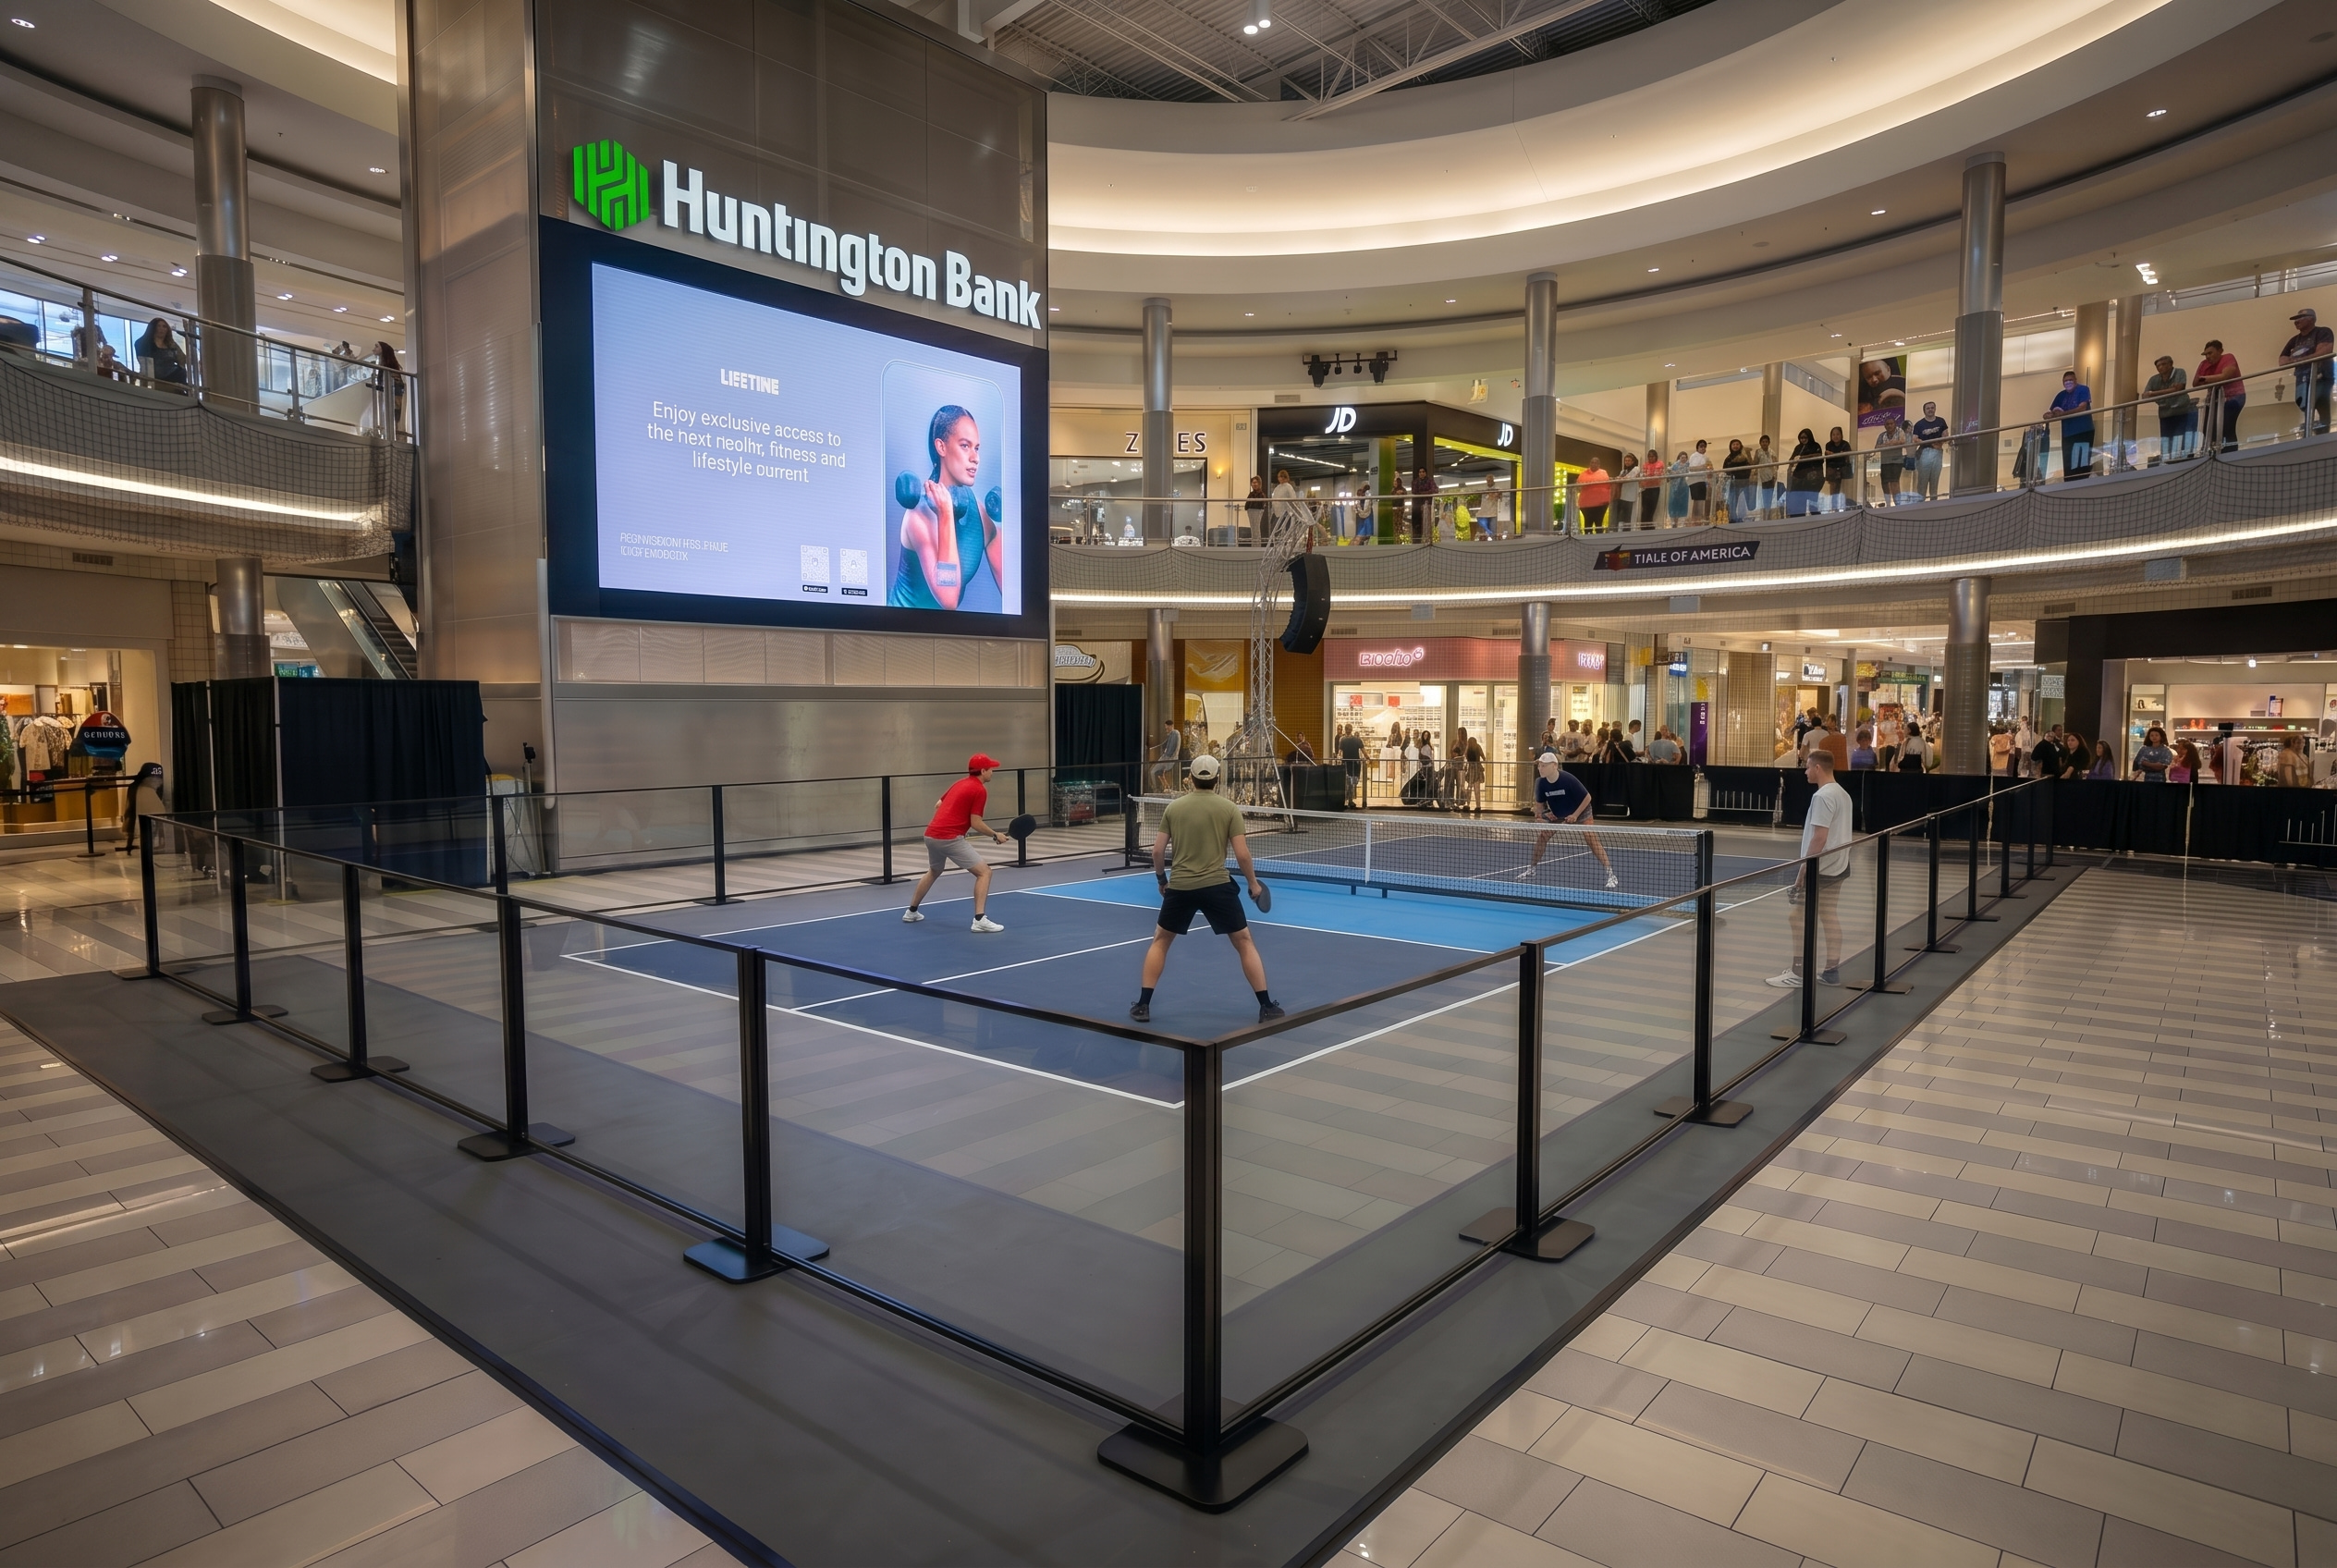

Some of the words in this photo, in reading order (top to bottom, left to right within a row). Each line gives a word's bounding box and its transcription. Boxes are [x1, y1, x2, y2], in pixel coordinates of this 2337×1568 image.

[662, 158, 937, 300] Huntington
[946, 250, 1043, 330] Bank
[653, 400, 696, 427] Enjoy
[701, 412, 771, 435] exclusive
[775, 423, 824, 445] access
[827, 431, 841, 447] to
[1325, 407, 1357, 435] JD
[1497, 422, 1514, 447] JD
[647, 423, 674, 442] the
[678, 428, 712, 447] next
[770, 440, 817, 463] fitness
[821, 452, 846, 468] and
[1125, 431, 1208, 454] ZES
[692, 450, 752, 476] lifestyle
[1670, 550, 1688, 562] OF
[1690, 546, 1751, 561] AMERICA
